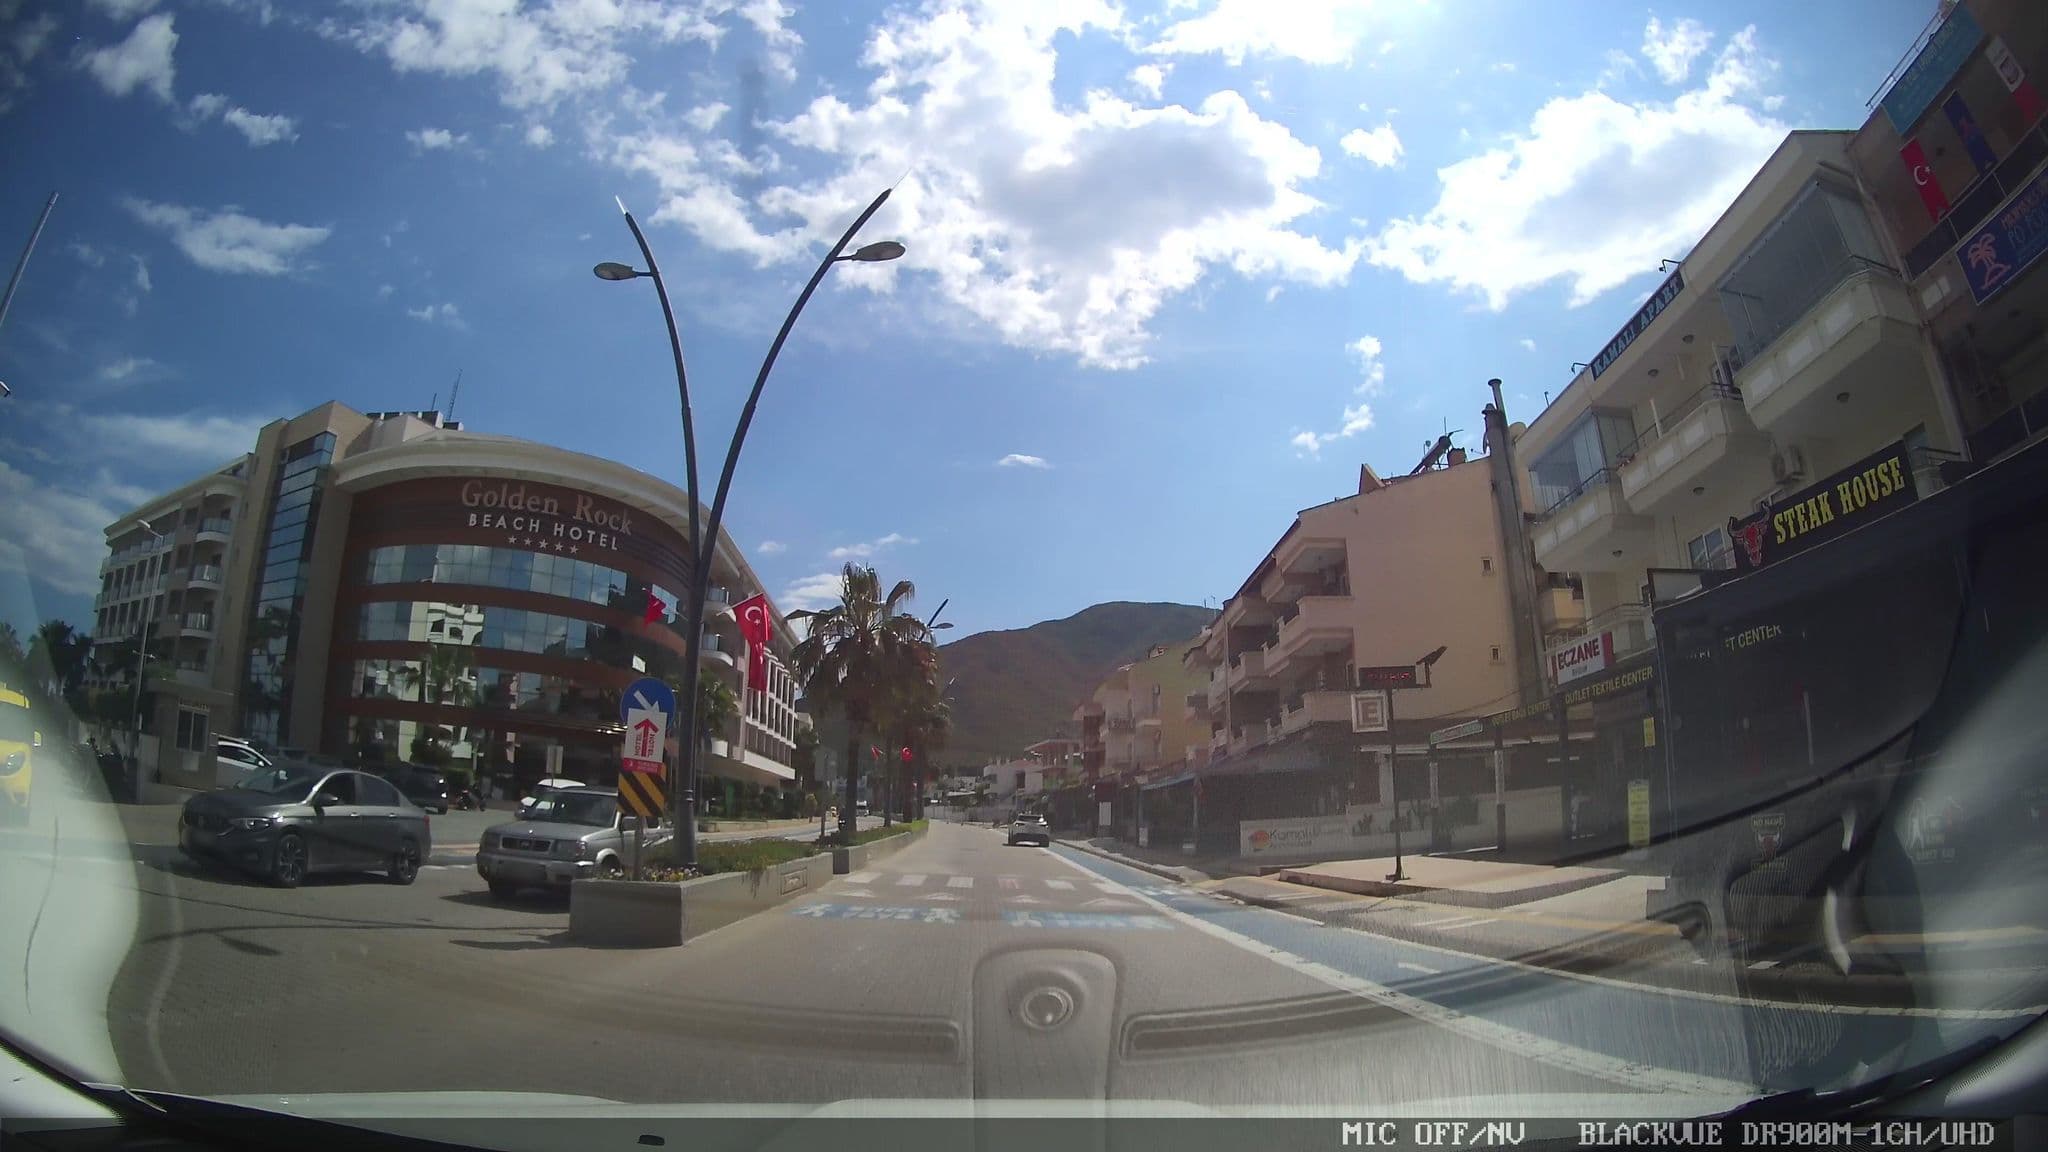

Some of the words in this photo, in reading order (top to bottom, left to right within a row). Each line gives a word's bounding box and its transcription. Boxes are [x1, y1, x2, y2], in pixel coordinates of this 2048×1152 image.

[462, 479, 559, 516] Golden
[573, 494, 633, 536] Rock
[1773, 491, 1835, 545] STEAK
[1837, 456, 1905, 514] HOUSE
[469, 513, 540, 533] BEACH
[553, 522, 618, 551] HOTEL
[1558, 638, 1600, 670] ECZANE
[1565, 687, 1591, 705] OUTLET
[1622, 666, 1654, 687] CENTER
